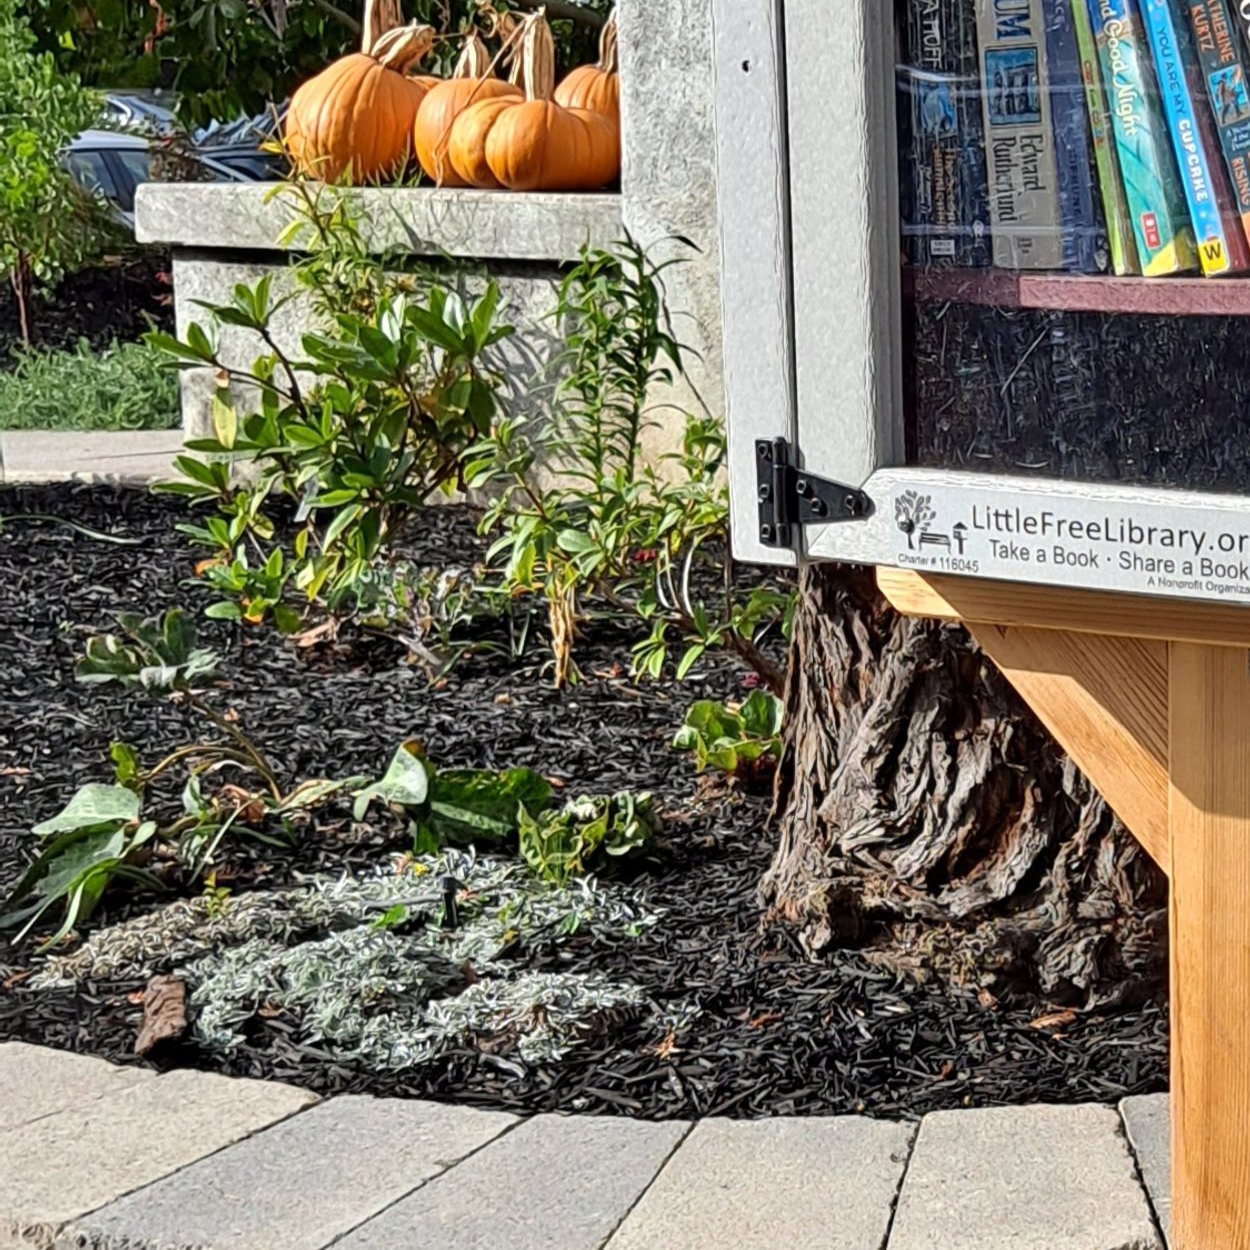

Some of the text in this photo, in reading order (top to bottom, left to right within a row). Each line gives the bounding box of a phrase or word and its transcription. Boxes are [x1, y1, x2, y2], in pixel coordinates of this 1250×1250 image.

[1103, 19, 1129, 73] Good
[1191, 3, 1215, 53] KURTZ
[1113, 73, 1140, 138] Night
[1156, 26, 1209, 203] YOU ARE MY CUPCAKE
[1019, 134, 1046, 192] Edward
[1203, 242, 1221, 261] W
[939, 557, 979, 573] 116045
[988, 538, 1030, 562] Take
[1036, 548, 1047, 563] a
[1053, 545, 1099, 569] Book
[1118, 550, 1175, 574] Share
[1182, 560, 1193, 576] a
[1200, 557, 1250, 581] Book
[1158, 577, 1203, 591] Nonprofit
